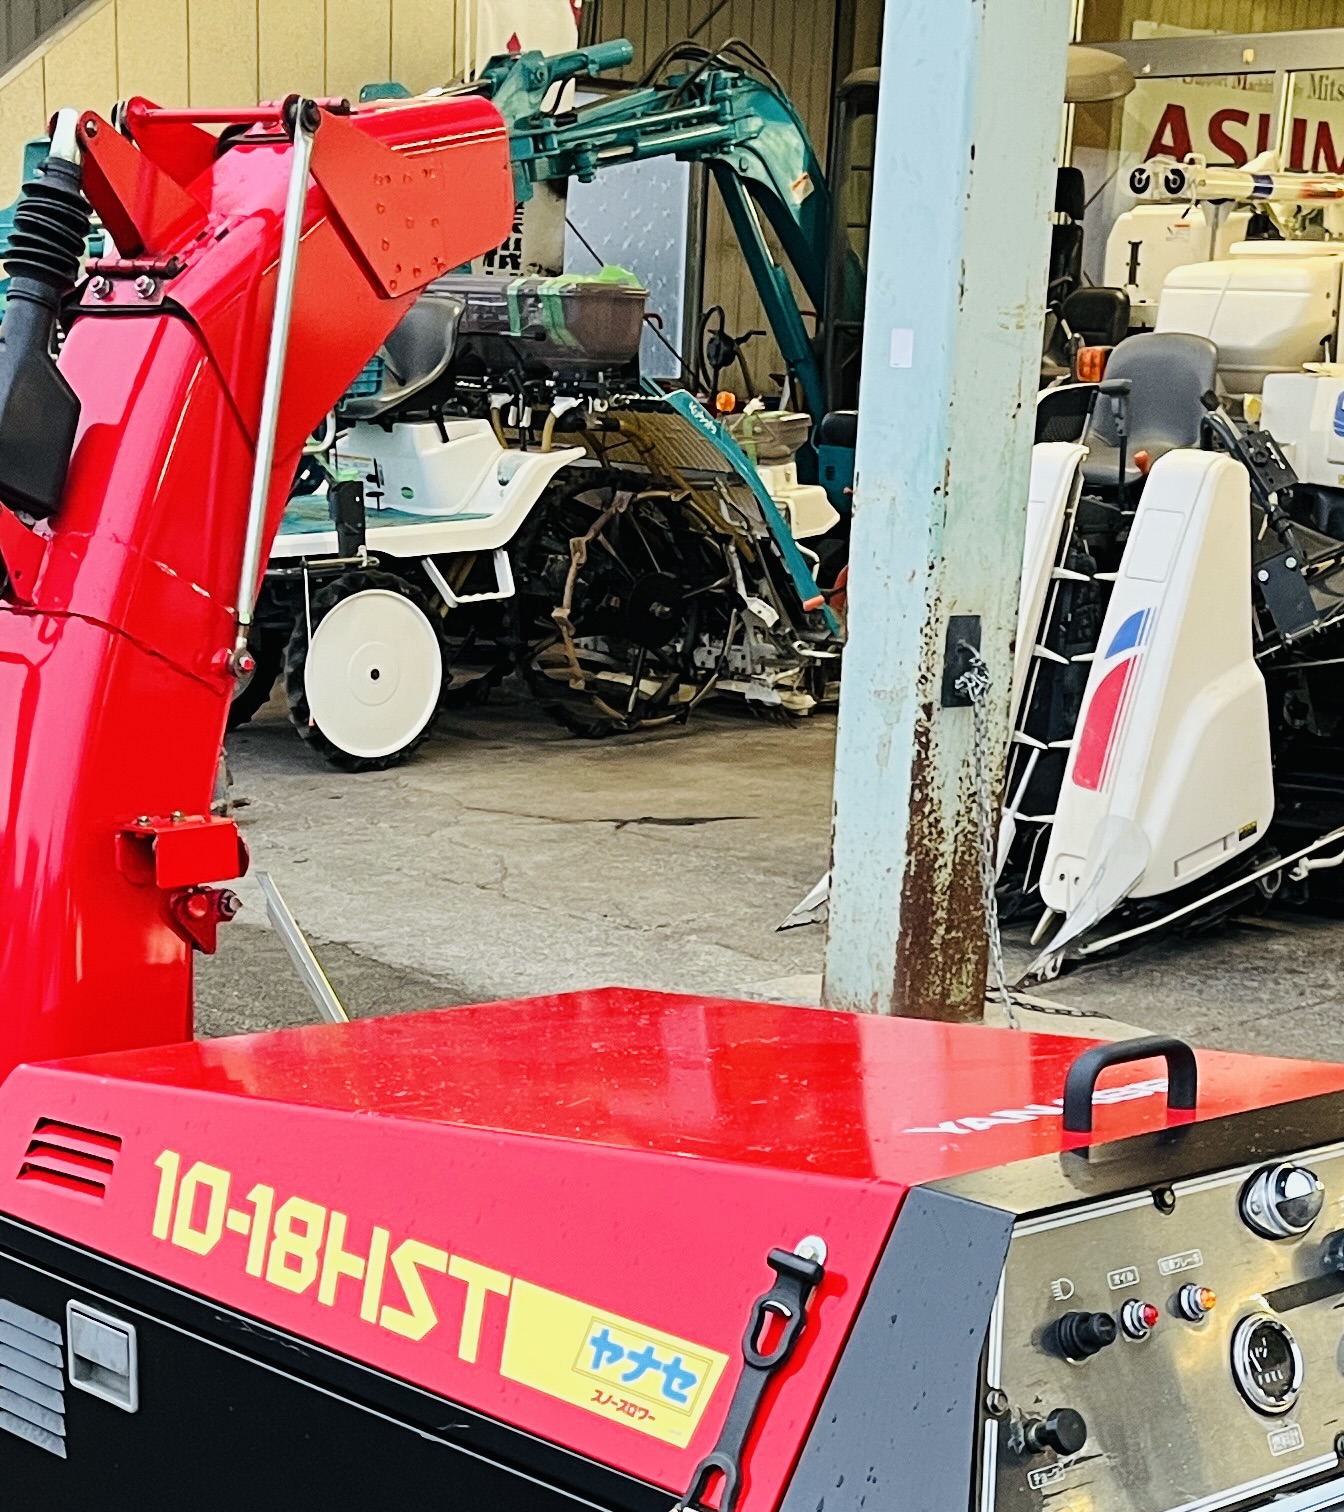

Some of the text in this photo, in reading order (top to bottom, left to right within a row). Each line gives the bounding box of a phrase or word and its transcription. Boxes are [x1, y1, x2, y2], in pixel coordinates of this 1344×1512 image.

[152, 1149, 513, 1364] 10-18HST
[588, 1327, 698, 1405] ヤナセ
[590, 1388, 656, 1421] スノースロワー
